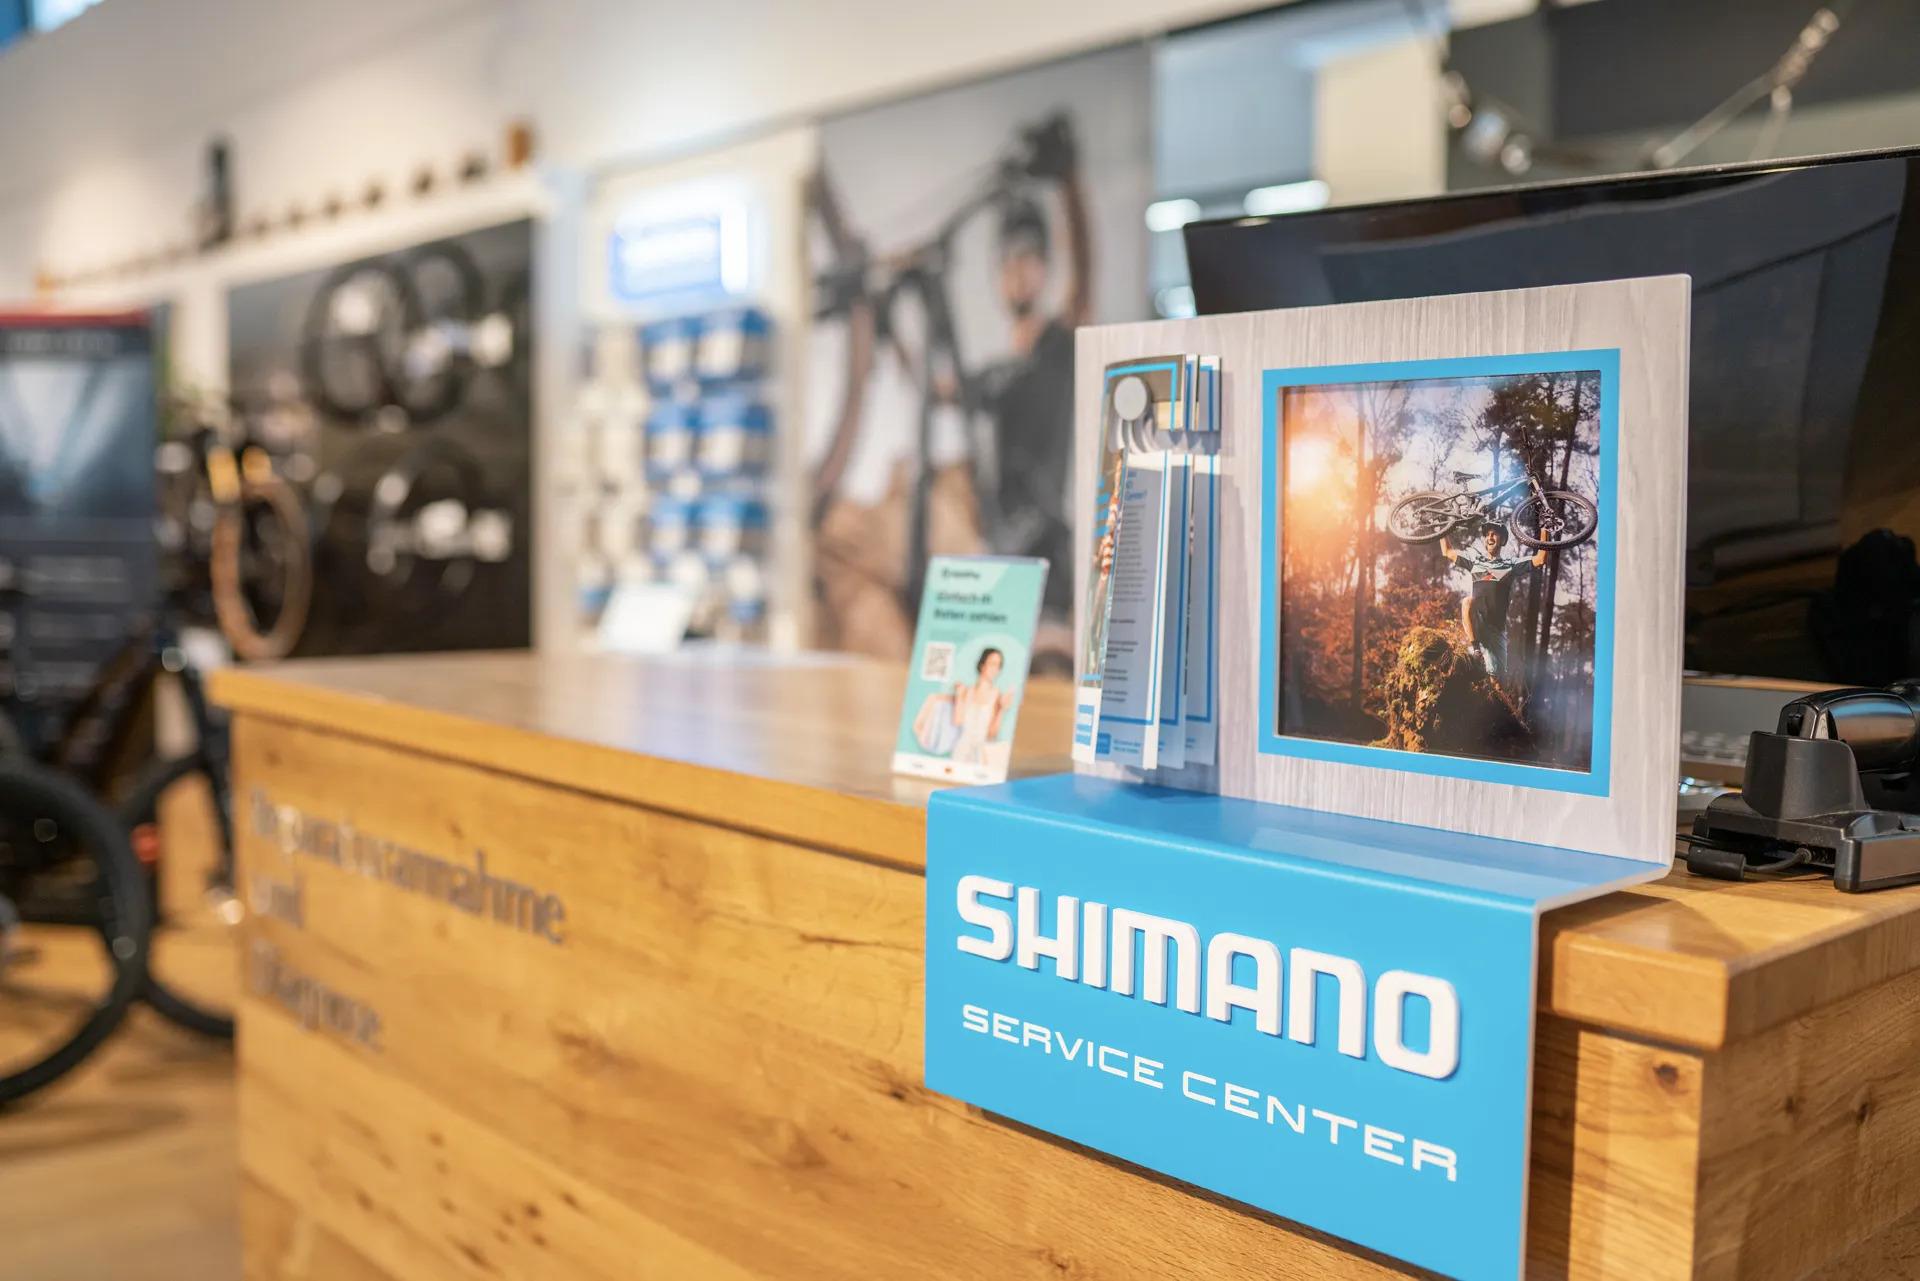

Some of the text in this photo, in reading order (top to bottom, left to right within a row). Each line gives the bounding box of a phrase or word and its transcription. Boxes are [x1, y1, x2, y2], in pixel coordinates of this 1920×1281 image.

[956, 875, 1460, 1081] SHIMANO
[963, 1004, 1458, 1182] SERVICE CENTER
